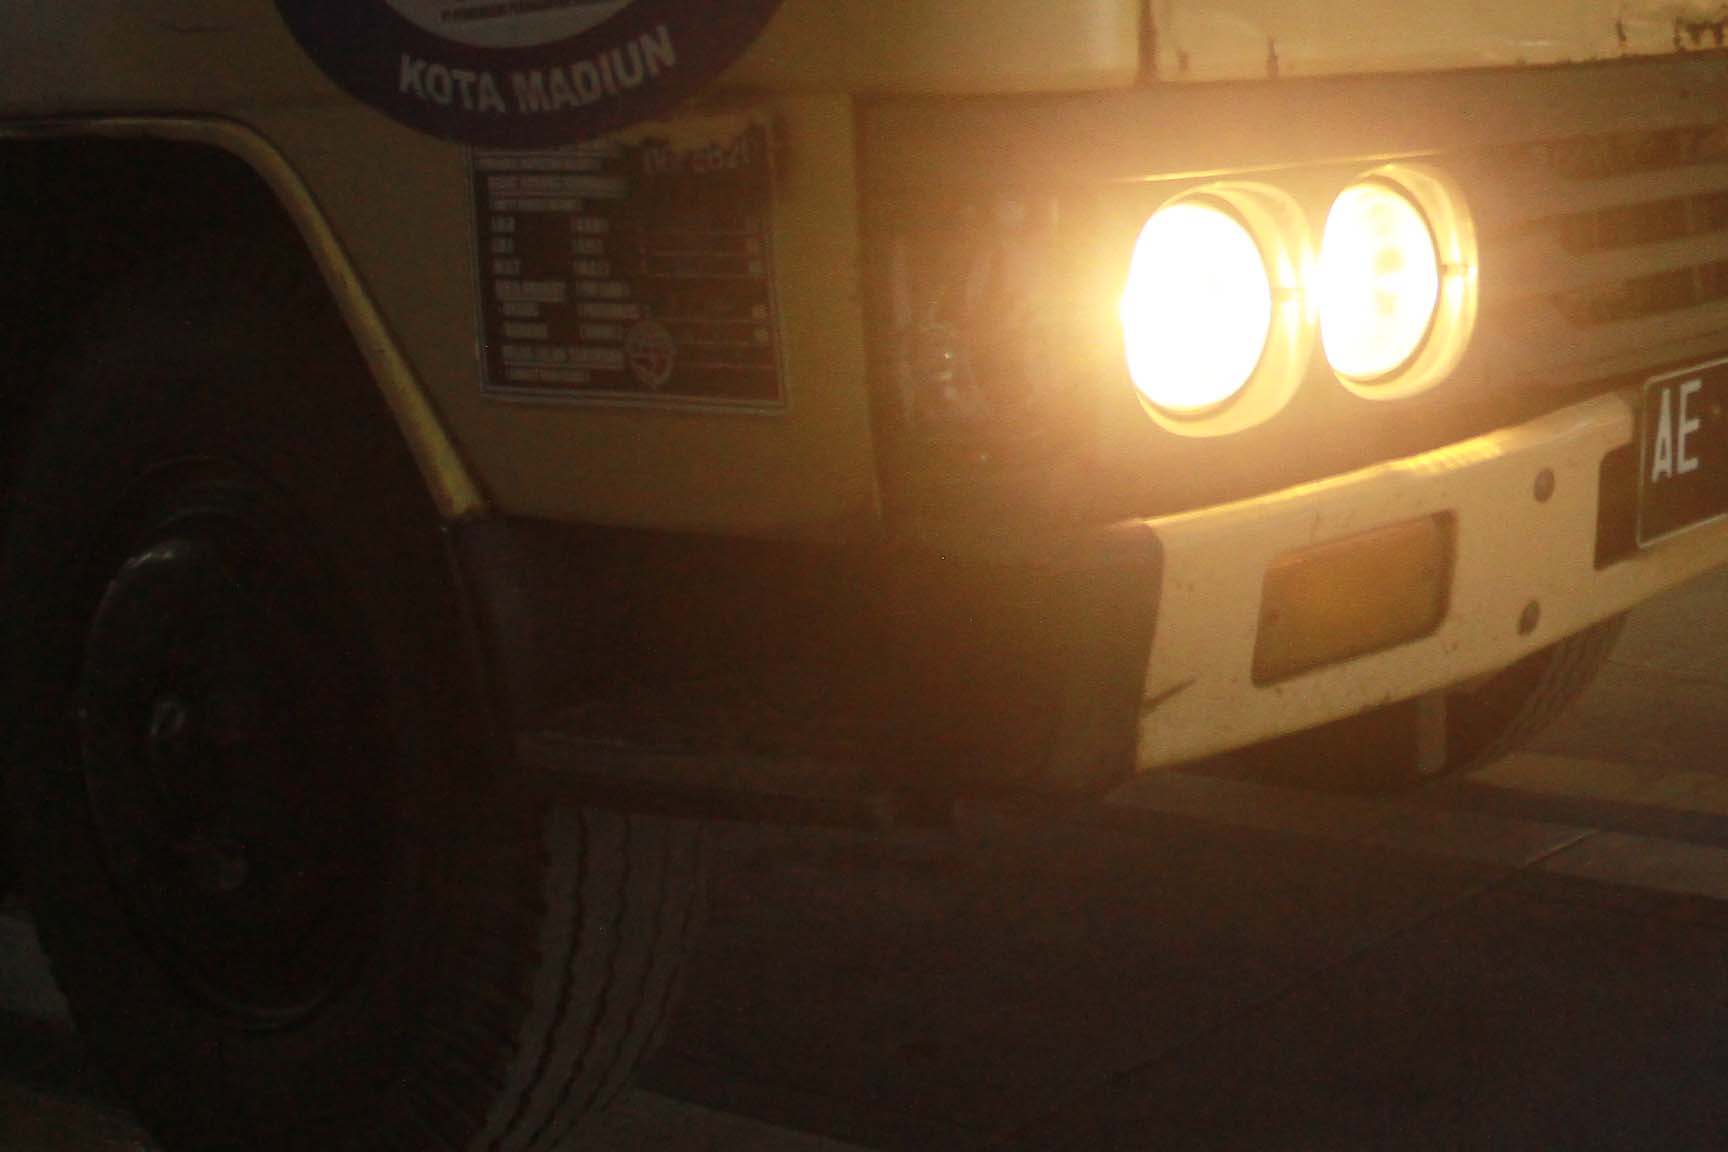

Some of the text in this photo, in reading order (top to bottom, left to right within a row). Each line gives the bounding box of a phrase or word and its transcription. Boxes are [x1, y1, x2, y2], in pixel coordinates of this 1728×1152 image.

[397, 26, 676, 113] KOTA MADIUN
[1651, 378, 1703, 483] AE
